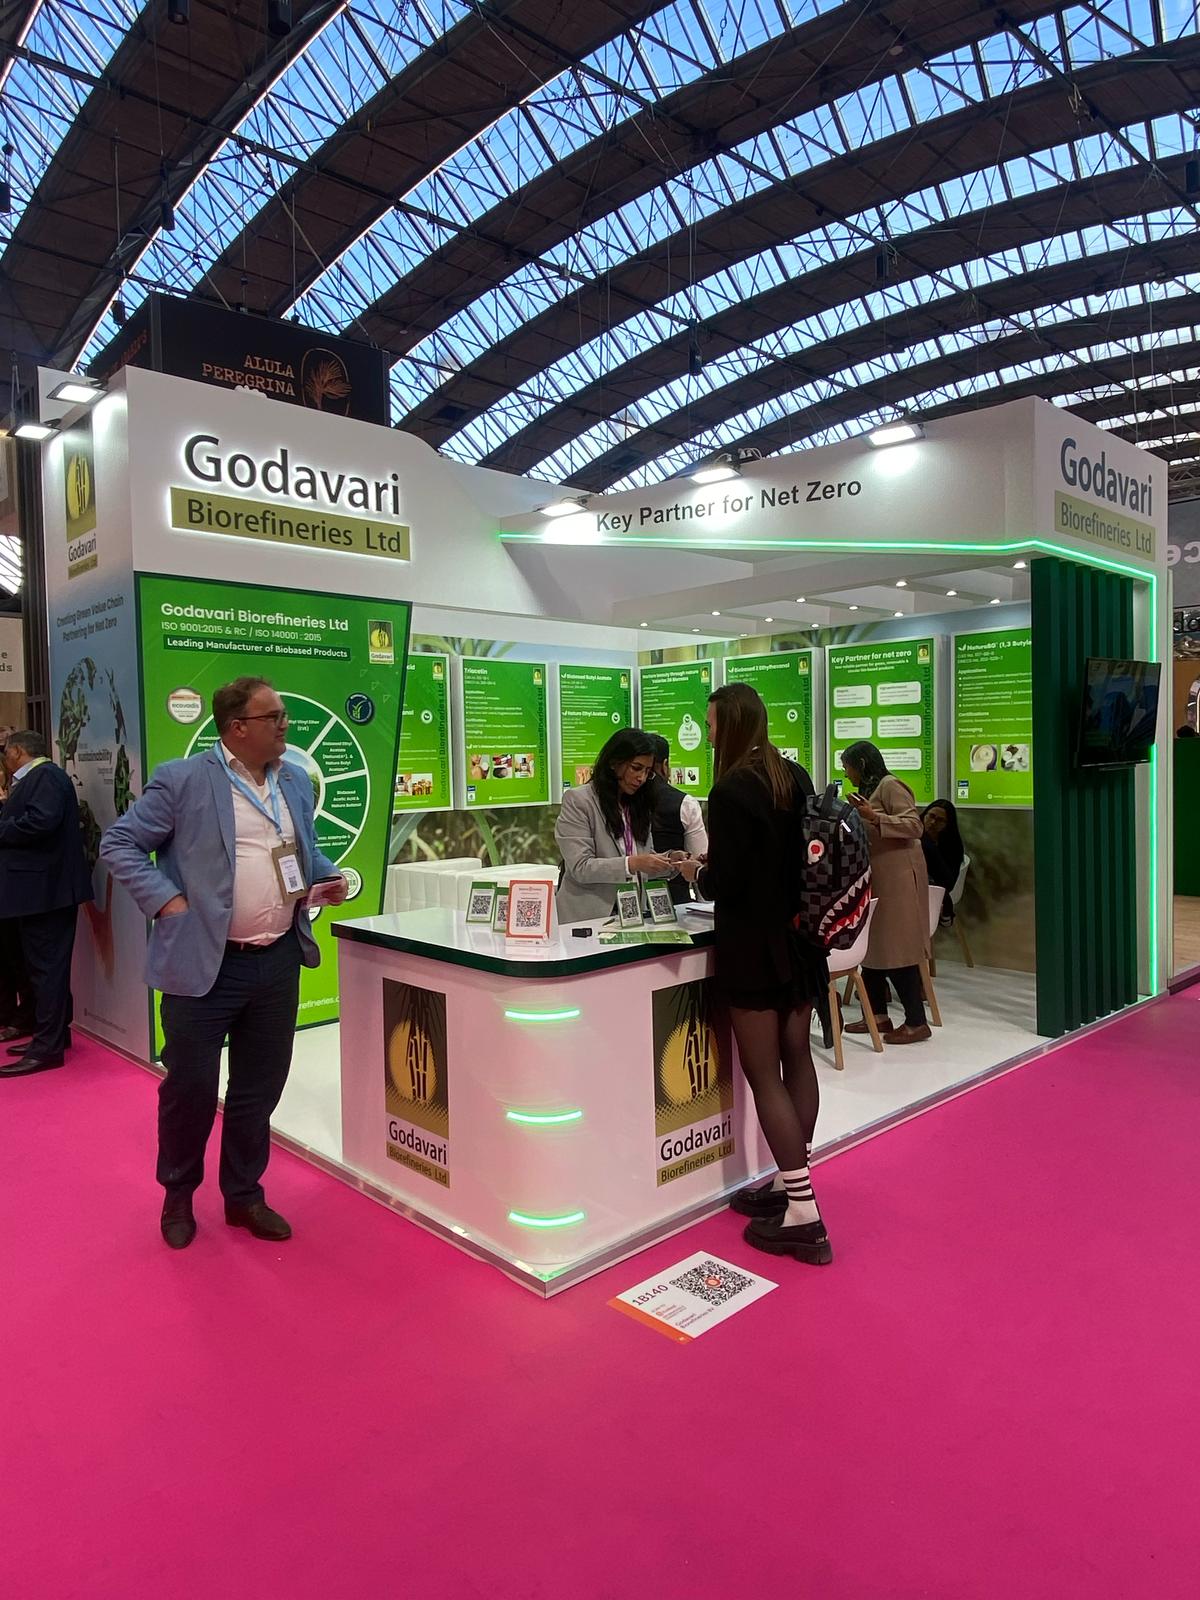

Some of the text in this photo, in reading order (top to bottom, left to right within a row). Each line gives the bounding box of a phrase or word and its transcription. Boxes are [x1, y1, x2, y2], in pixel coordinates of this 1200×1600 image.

[202, 361, 296, 396] PEREGRINA
[244, 354, 295, 379] ALULA
[184, 434, 400, 515] Godavari
[1060, 438, 1152, 516] Godavari
[596, 478, 863, 533] Key Partner for Net Zero
[188, 498, 401, 553] Biorefineries Ltd
[1060, 502, 1152, 554] Biorefineries Ltd
[68, 532, 97, 562] Godavari
[160, 602, 349, 632] Godavari Biorefineries Ltd
[161, 621, 177, 630] ISO
[224, 626, 232, 635] &
[234, 627, 247, 636] RC
[255, 629, 269, 638] ISO
[304, 632, 322, 641] 2015
[167, 638, 348, 658] Leading Manufacturer of Biobased Products
[831, 656, 844, 664] Key
[845, 654, 870, 662] Partner
[388, 1120, 447, 1166] Godavari
[660, 1114, 732, 1162] Godavari
[388, 1146, 447, 1184] Biorefineries Ltd
[660, 1142, 732, 1183] Biorefineries Ltd
[632, 1284, 668, 1306] 1B140
